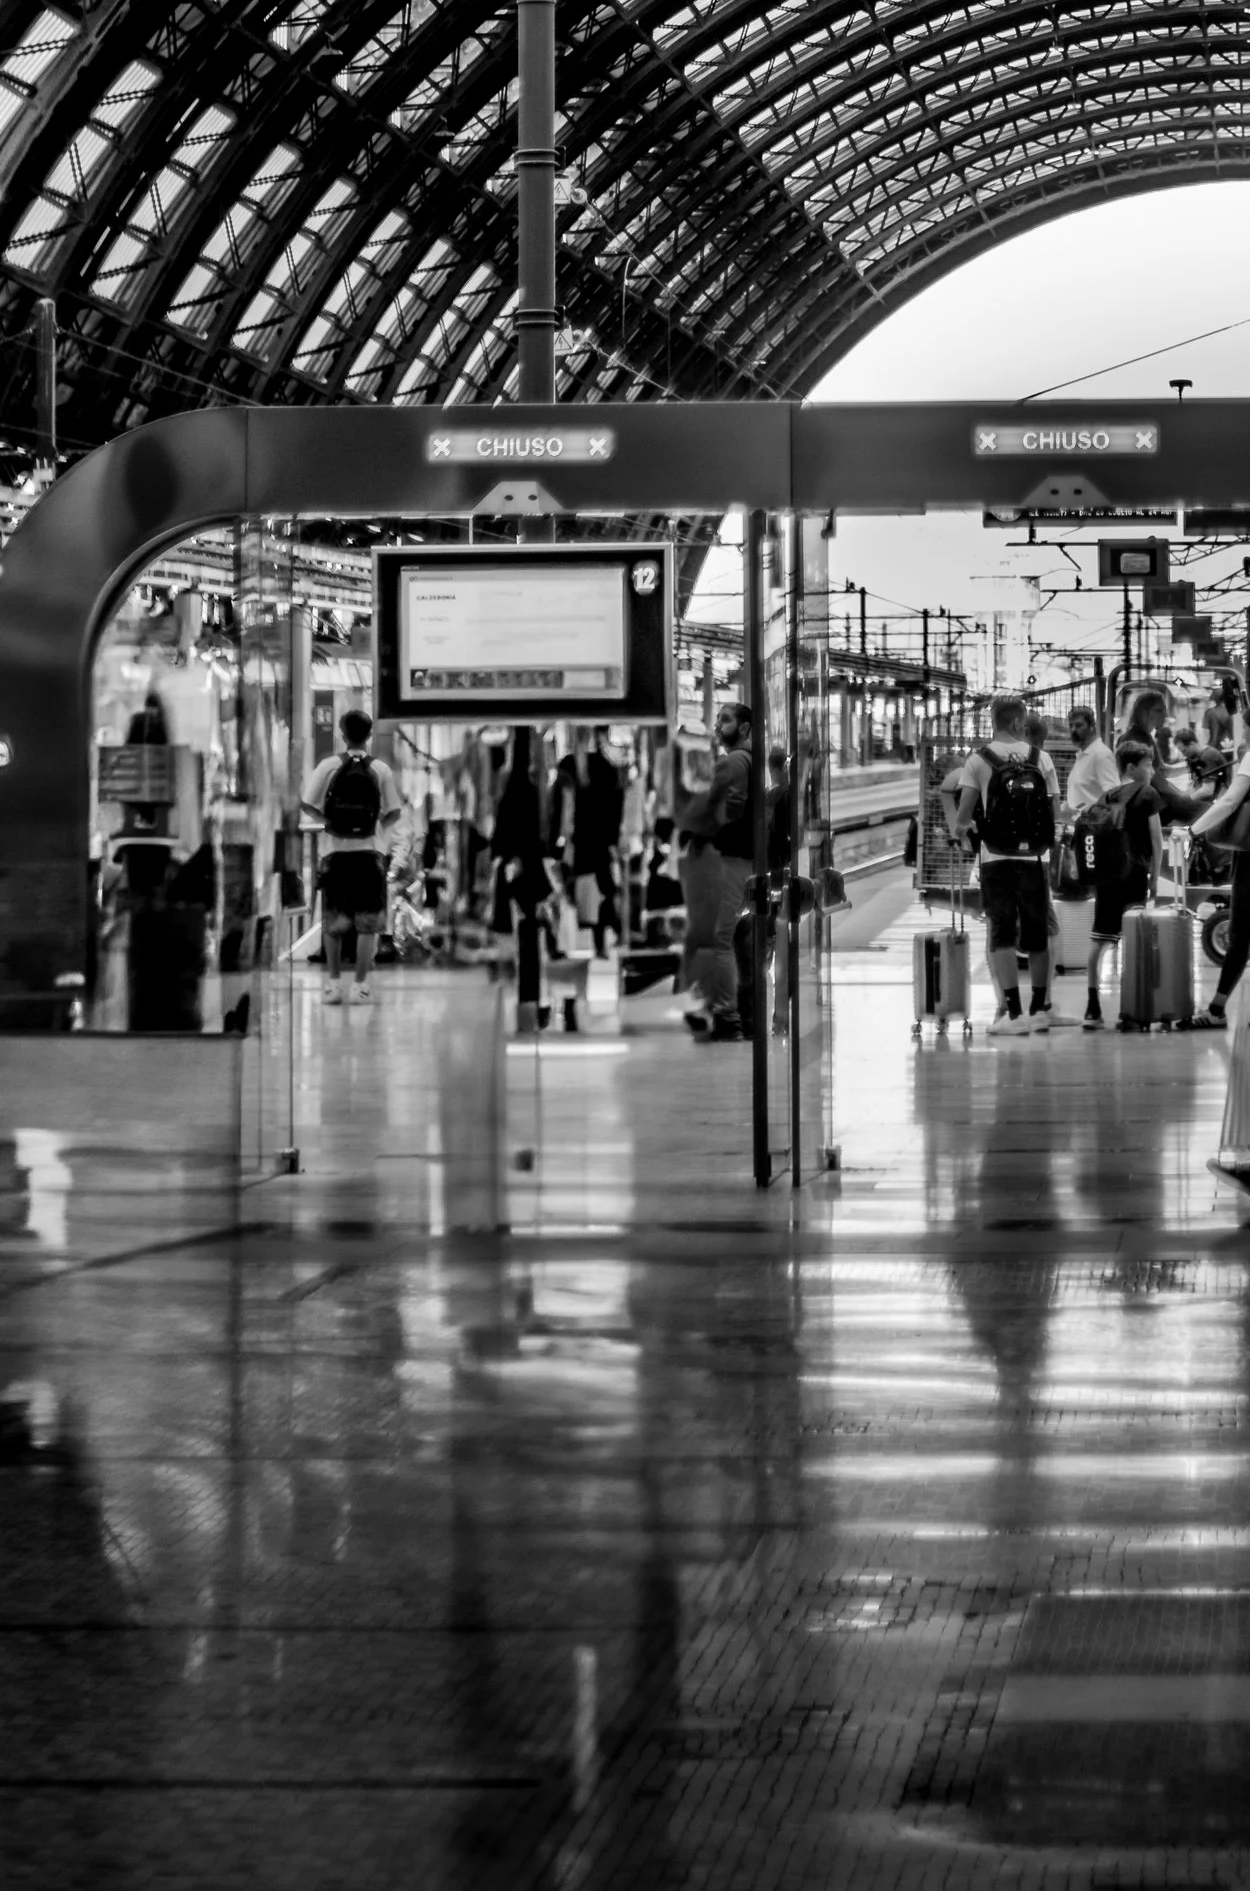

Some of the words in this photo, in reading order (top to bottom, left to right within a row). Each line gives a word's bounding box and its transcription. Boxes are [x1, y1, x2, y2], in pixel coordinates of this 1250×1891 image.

[476, 436, 564, 457] CHIUSO
[1022, 430, 1110, 451] CHIUSO
[633, 567, 655, 590] 12
